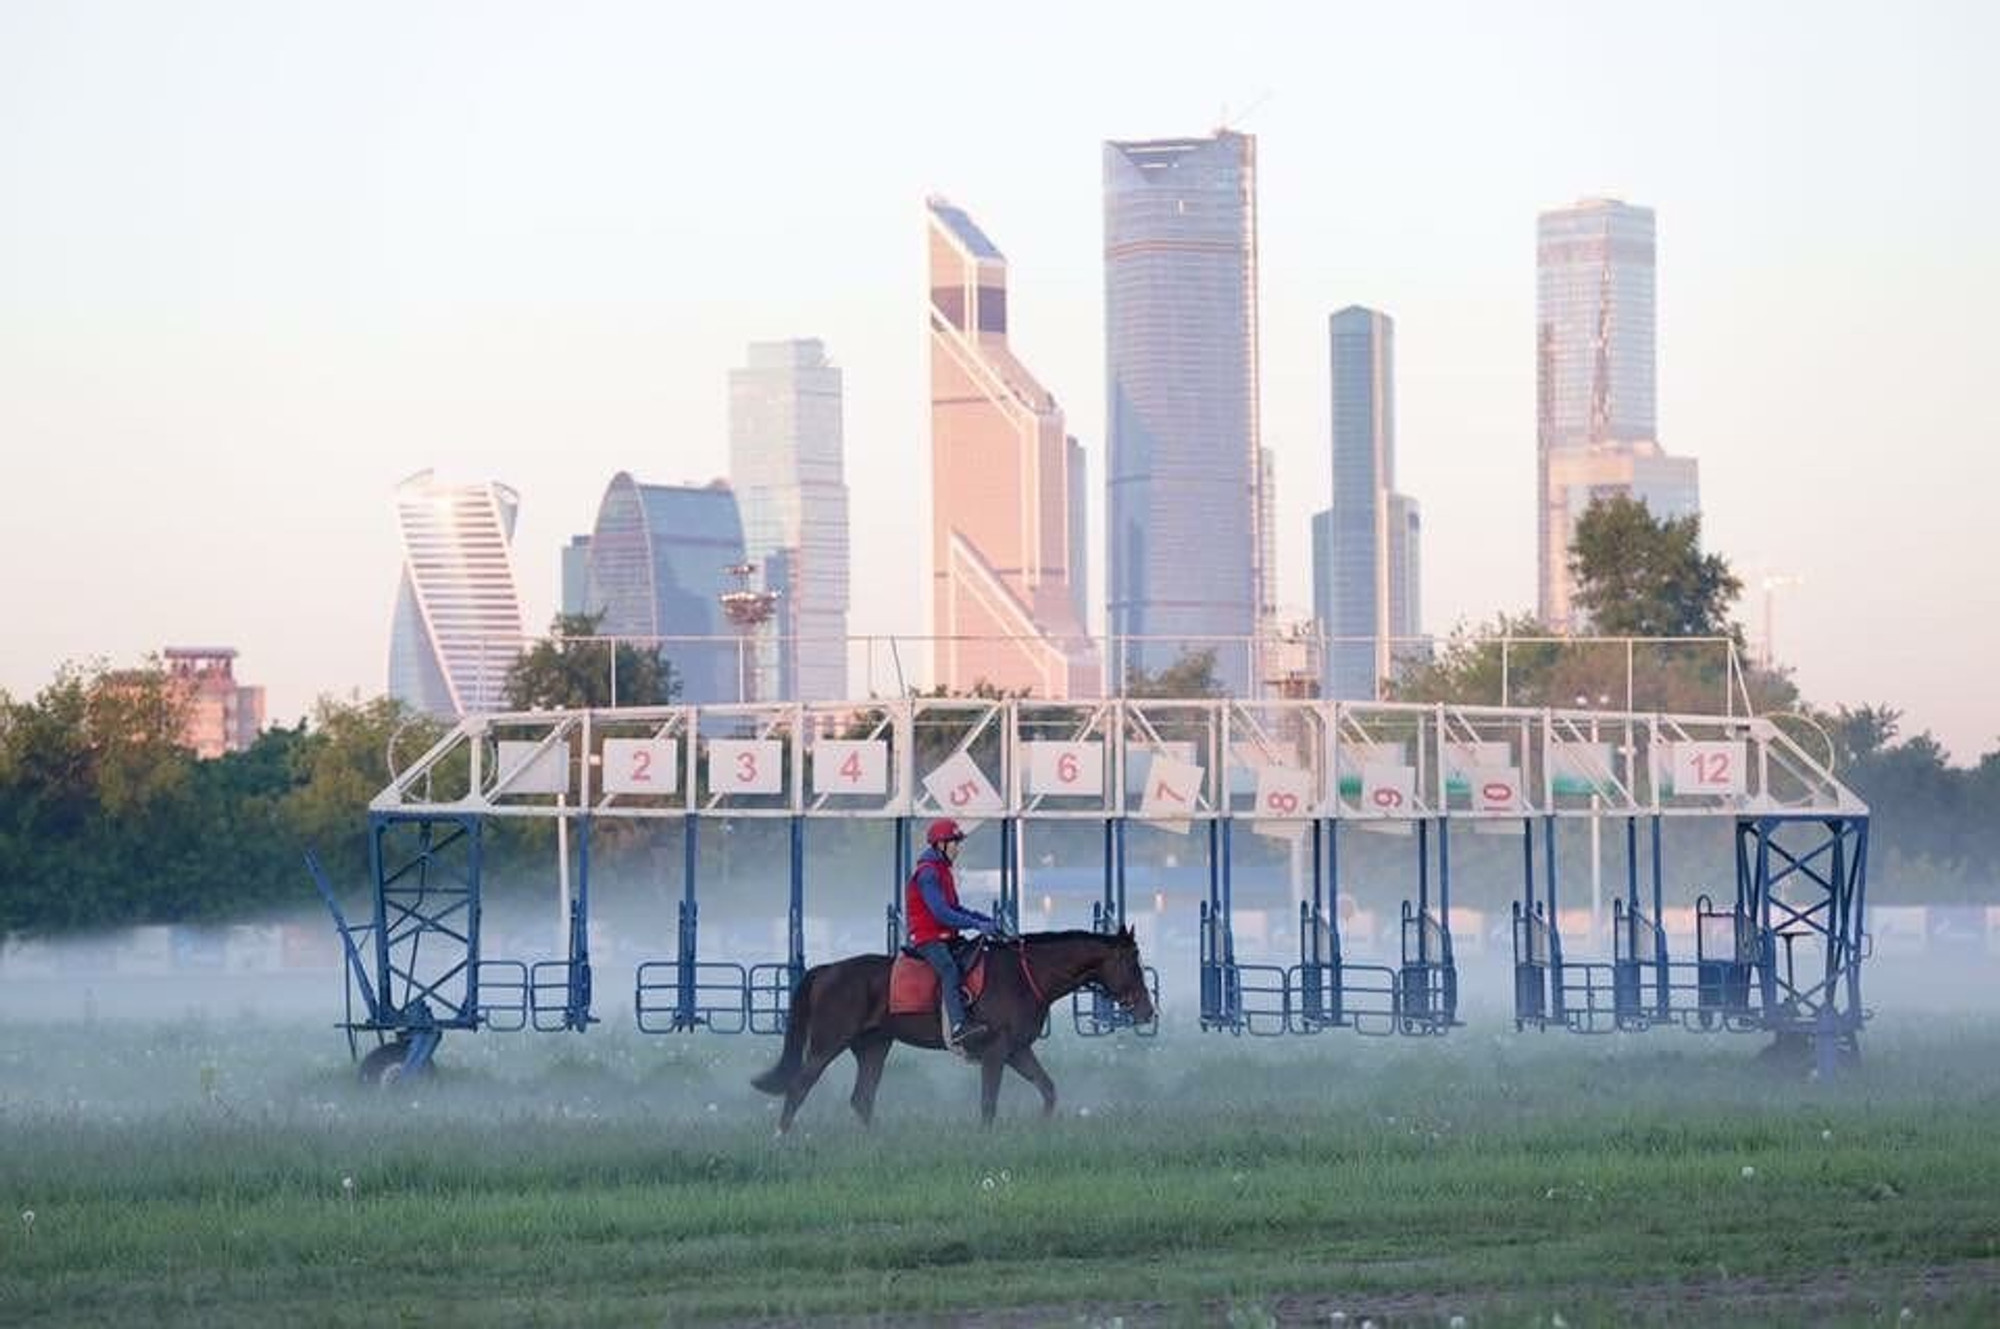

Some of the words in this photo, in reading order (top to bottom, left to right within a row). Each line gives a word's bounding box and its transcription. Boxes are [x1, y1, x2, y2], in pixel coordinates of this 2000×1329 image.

[631, 749, 655, 786] 2
[737, 749, 759, 786] 3
[838, 750, 863, 784] 4
[1057, 753, 1079, 785] 6
[1690, 752, 1729, 784] 12
[950, 779, 980, 807] 5
[1155, 779, 1186, 803] 7
[1267, 792, 1299, 813] 8
